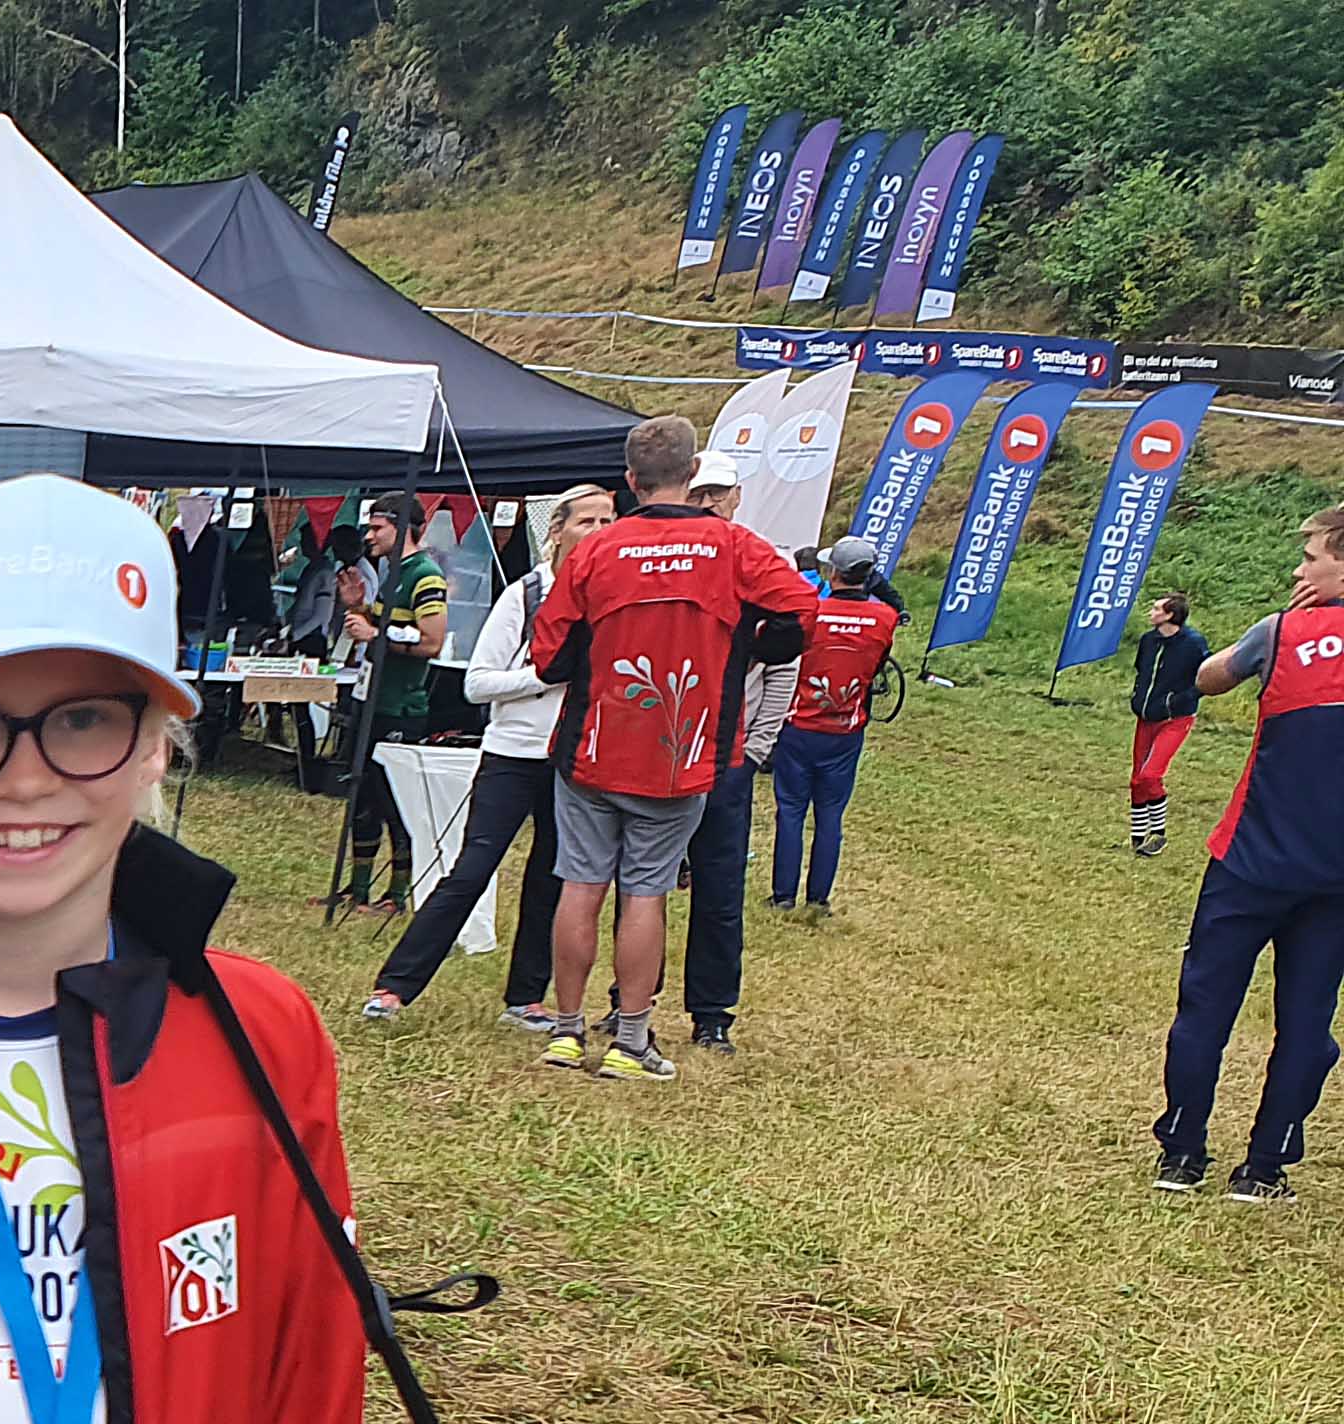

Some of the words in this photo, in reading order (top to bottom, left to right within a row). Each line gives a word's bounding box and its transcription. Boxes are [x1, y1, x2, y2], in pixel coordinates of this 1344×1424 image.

[736, 150, 783, 238] INEOS
[776, 168, 814, 242] inovyn
[856, 174, 903, 269] INEOS
[896, 185, 939, 265] inovyn
[875, 340, 924, 358] SpareBank
[951, 343, 1005, 361] SpareBank
[1030, 346, 1087, 367] SpareBank
[1288, 373, 1335, 390] Vianode
[914, 416, 942, 434] 1
[1010, 428, 1038, 448] 1
[1140, 436, 1172, 455] 1
[863, 448, 917, 551] areBank
[618, 543, 717, 560] PORSGRUNN
[945, 464, 1015, 614] SpareBank
[979, 468, 1034, 595] SØRØST-NORGE
[1078, 472, 1148, 630] SpareBank
[1114, 476, 1168, 609] SØRØST-NORGE
[640, 560, 693, 574] O-LAG
